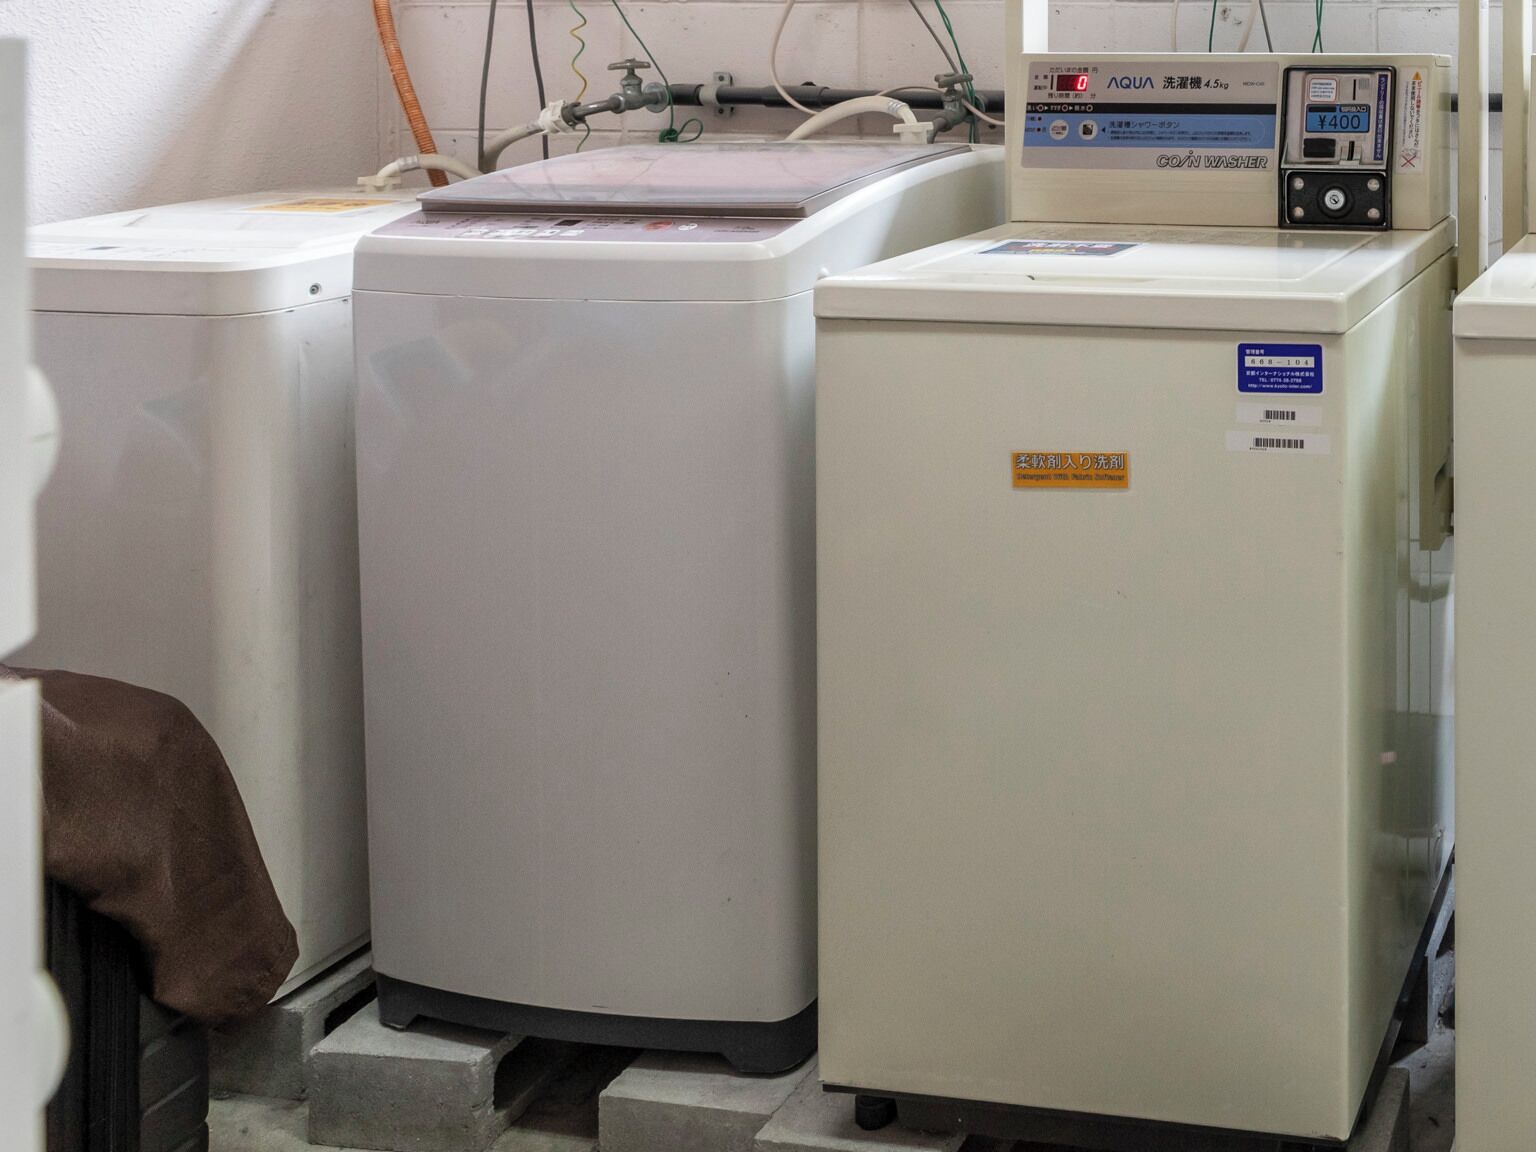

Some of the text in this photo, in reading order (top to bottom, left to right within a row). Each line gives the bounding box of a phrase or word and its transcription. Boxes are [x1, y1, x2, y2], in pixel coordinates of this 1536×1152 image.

[1077, 75, 1088, 90] 0
[1107, 76, 1229, 90] AQUA 洗濯機 4.5kg
[1109, 121, 1180, 129] 洗濯槽シャワーボタン
[1318, 114, 1361, 130] ¥400
[1156, 150, 1268, 168] COIN WASHER
[1016, 453, 1125, 470] 柔軟剤入り洗剤
